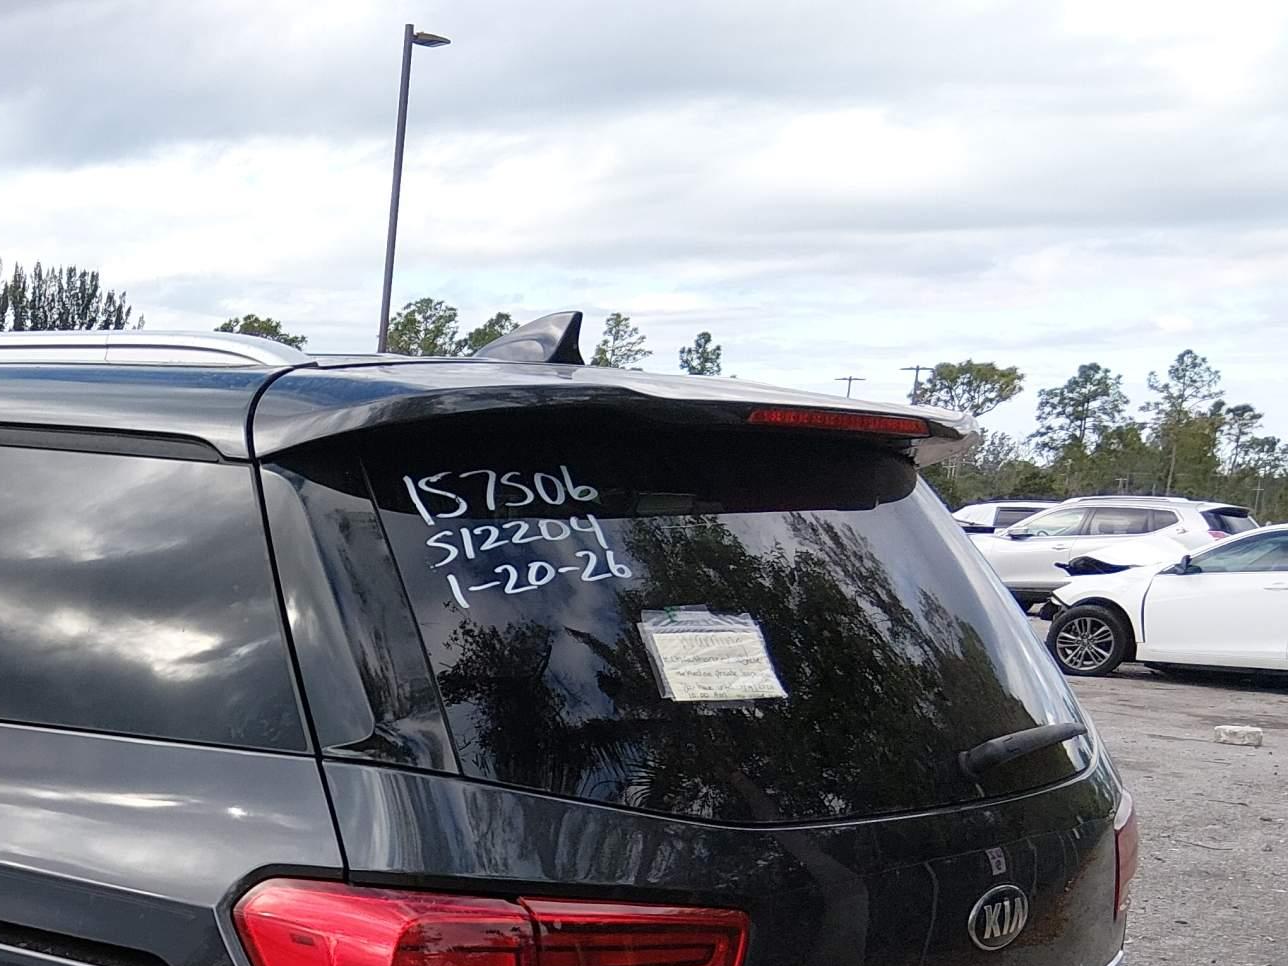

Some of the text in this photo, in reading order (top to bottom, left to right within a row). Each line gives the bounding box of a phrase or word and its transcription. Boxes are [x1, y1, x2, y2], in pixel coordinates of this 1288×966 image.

[402, 464, 599, 526] 157506
[446, 550, 633, 609] 1-20-26
[982, 896, 1025, 940] KIA
